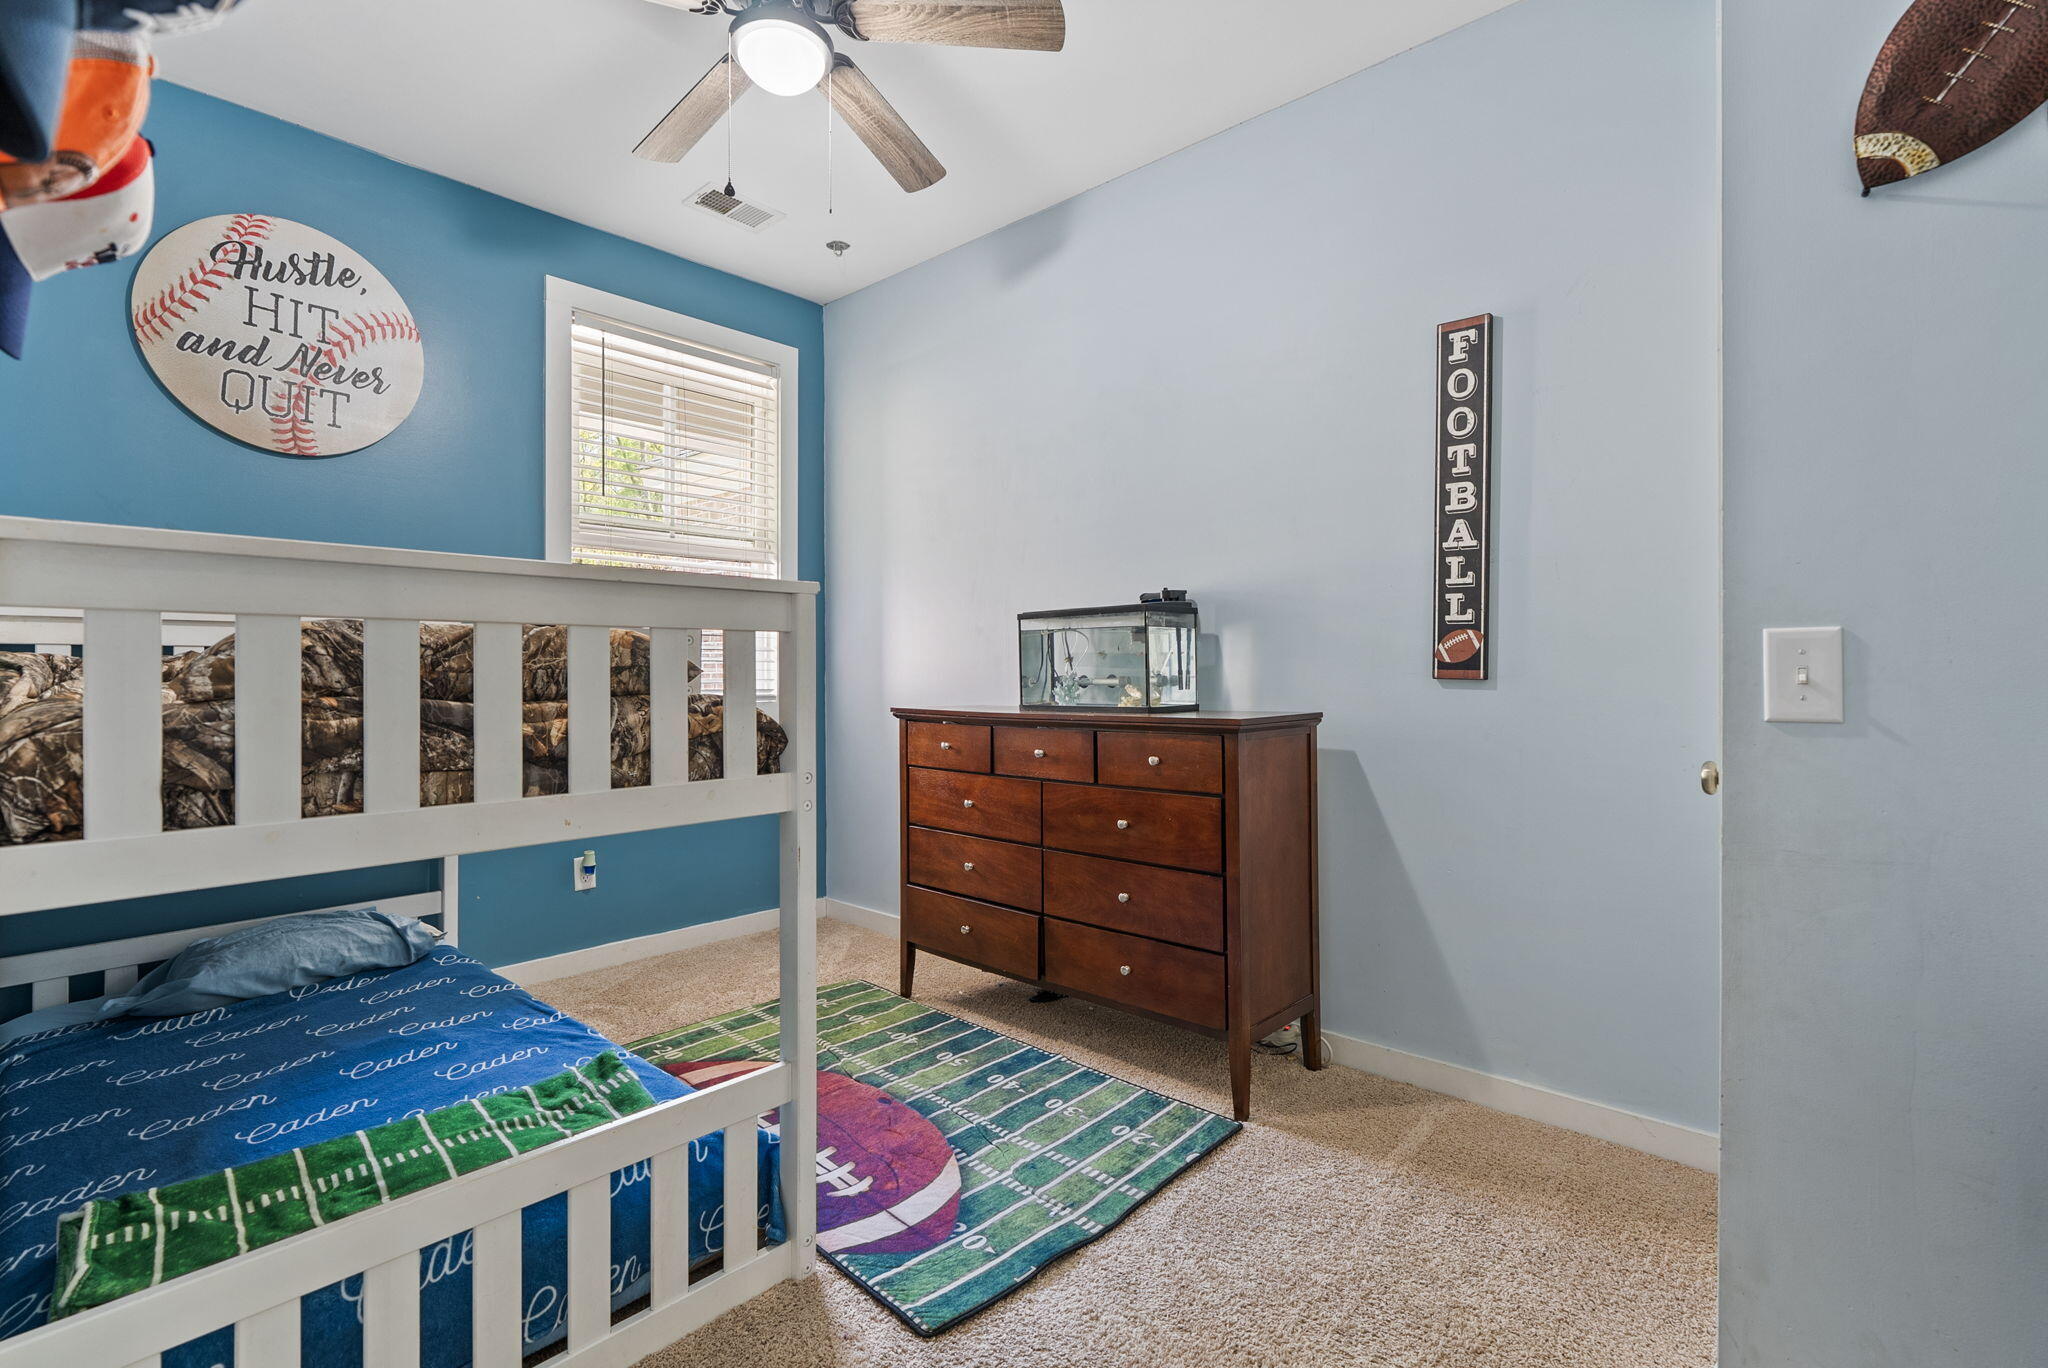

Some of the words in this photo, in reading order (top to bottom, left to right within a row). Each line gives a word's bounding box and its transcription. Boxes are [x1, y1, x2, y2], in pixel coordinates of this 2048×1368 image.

[209, 240, 367, 296] Hustle,
[242, 285, 340, 345] HIT
[176, 330, 273, 367] and
[273, 342, 391, 395] Never
[221, 368, 350, 429] QUIT
[1442, 328, 1480, 625] FOOTBALL
[360, 976, 456, 1004] Caden
[185, 1014, 309, 1047] Caden
[305, 1006, 416, 1037] Caden
[389, 1009, 494, 1036] Caden
[0, 1059, 116, 1098] aden
[106, 1052, 246, 1086] Caden
[202, 1050, 336, 1091] Caden
[339, 1041, 458, 1079] Caden
[434, 1046, 549, 1080] Caden
[128, 1094, 278, 1141] Caden
[234, 1098, 379, 1145] Caden
